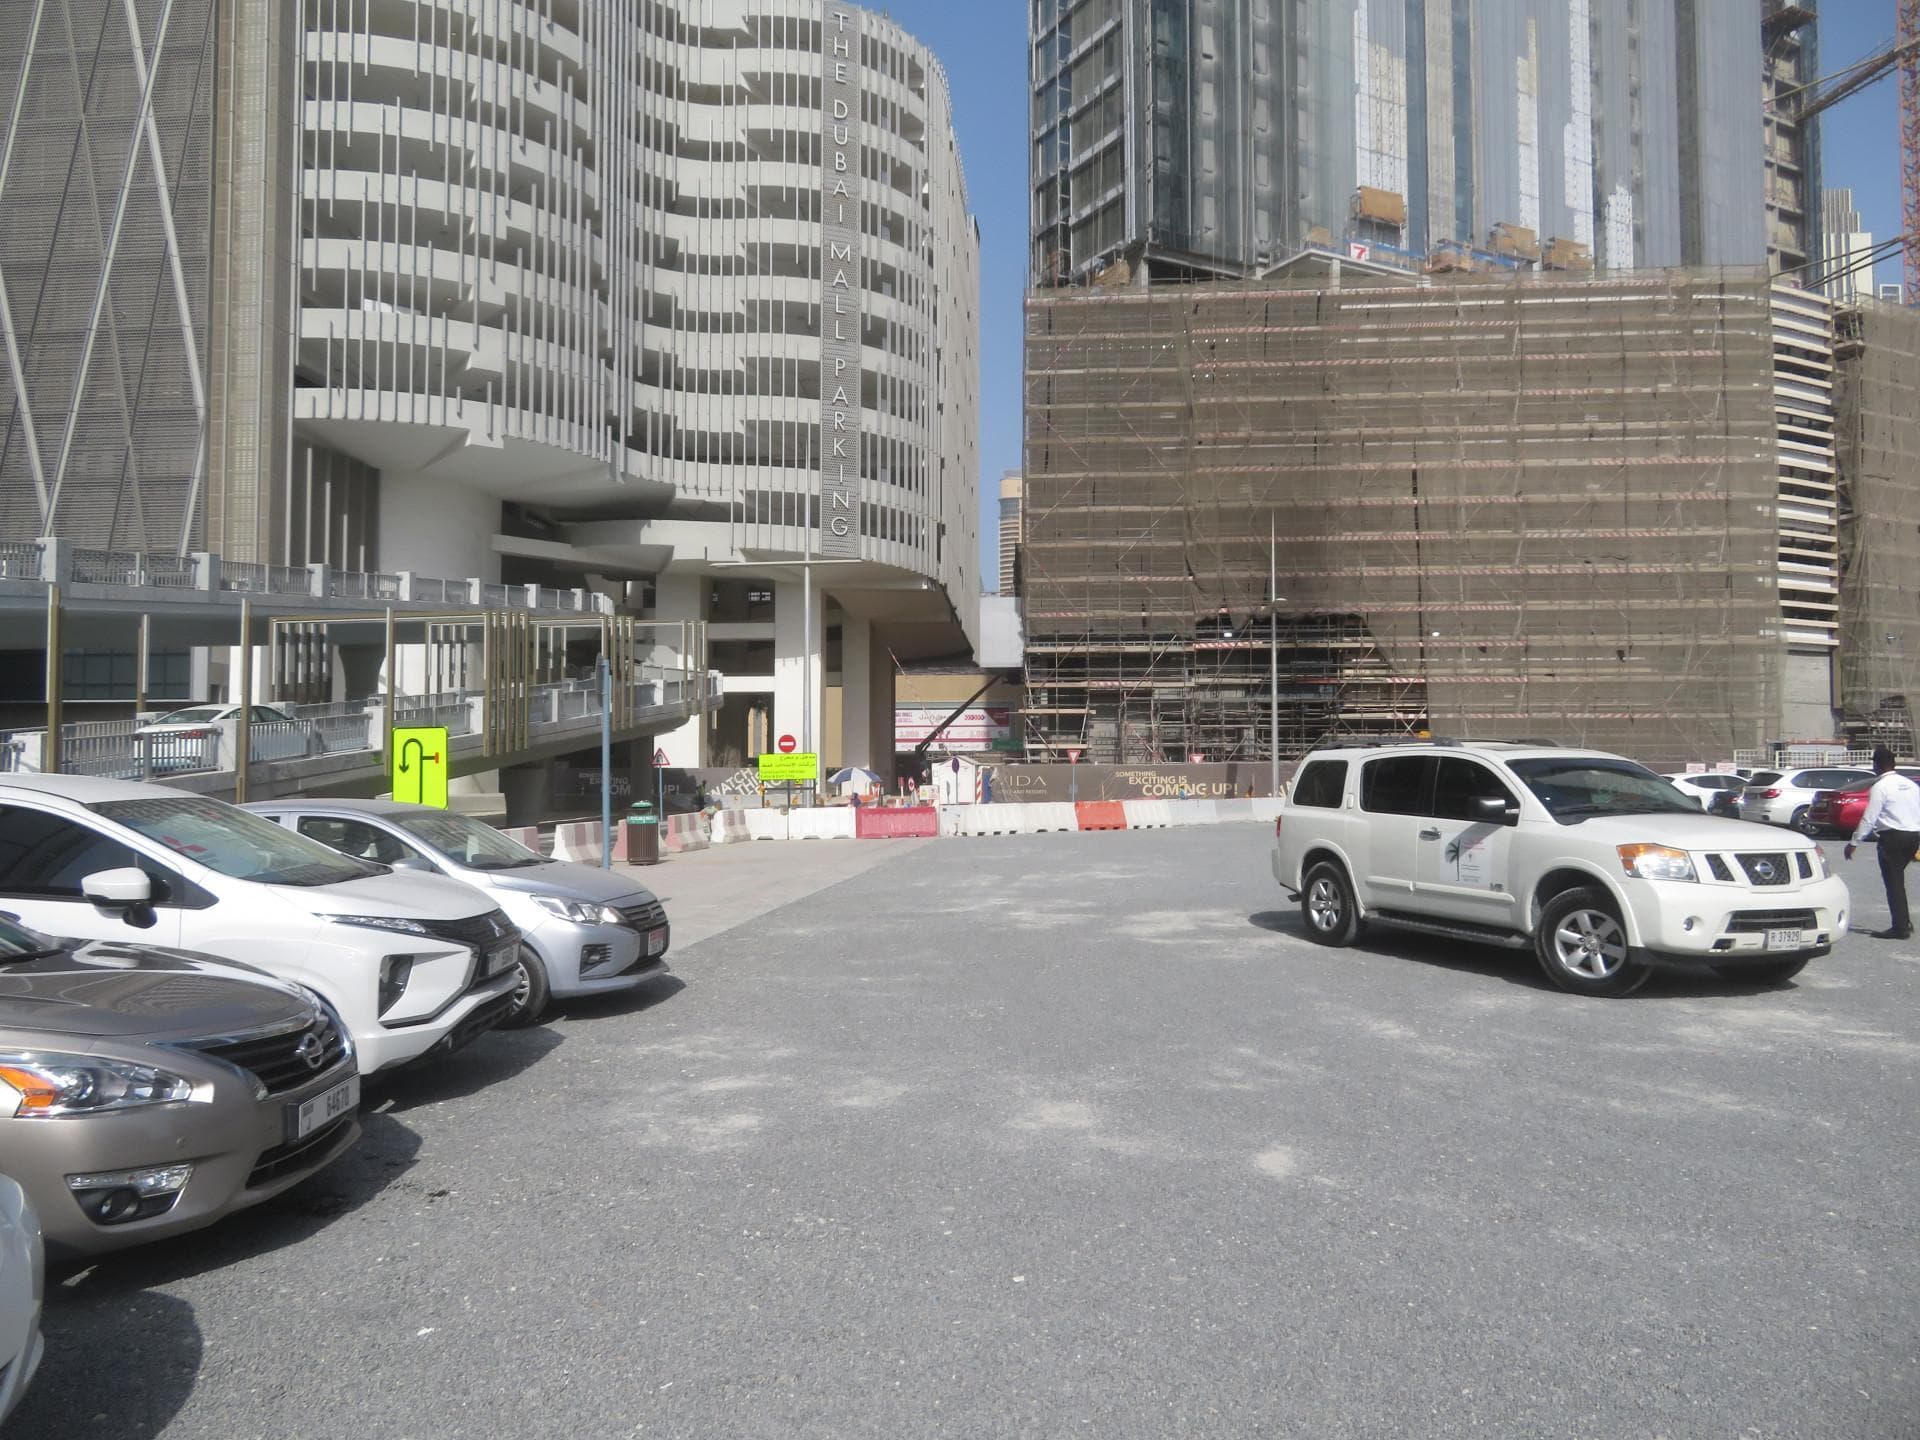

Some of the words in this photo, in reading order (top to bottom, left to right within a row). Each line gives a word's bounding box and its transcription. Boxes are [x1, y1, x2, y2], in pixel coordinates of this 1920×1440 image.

[833, 12, 849, 84] THE
[833, 99, 849, 224] DUBAI
[1353, 245, 1367, 259] 7
[830, 243, 851, 341] MALL
[831, 357, 850, 536] PARKING
[1128, 776, 1176, 785] EXCITING
[1178, 775, 1188, 784] IS
[1212, 783, 1239, 795] UP!
